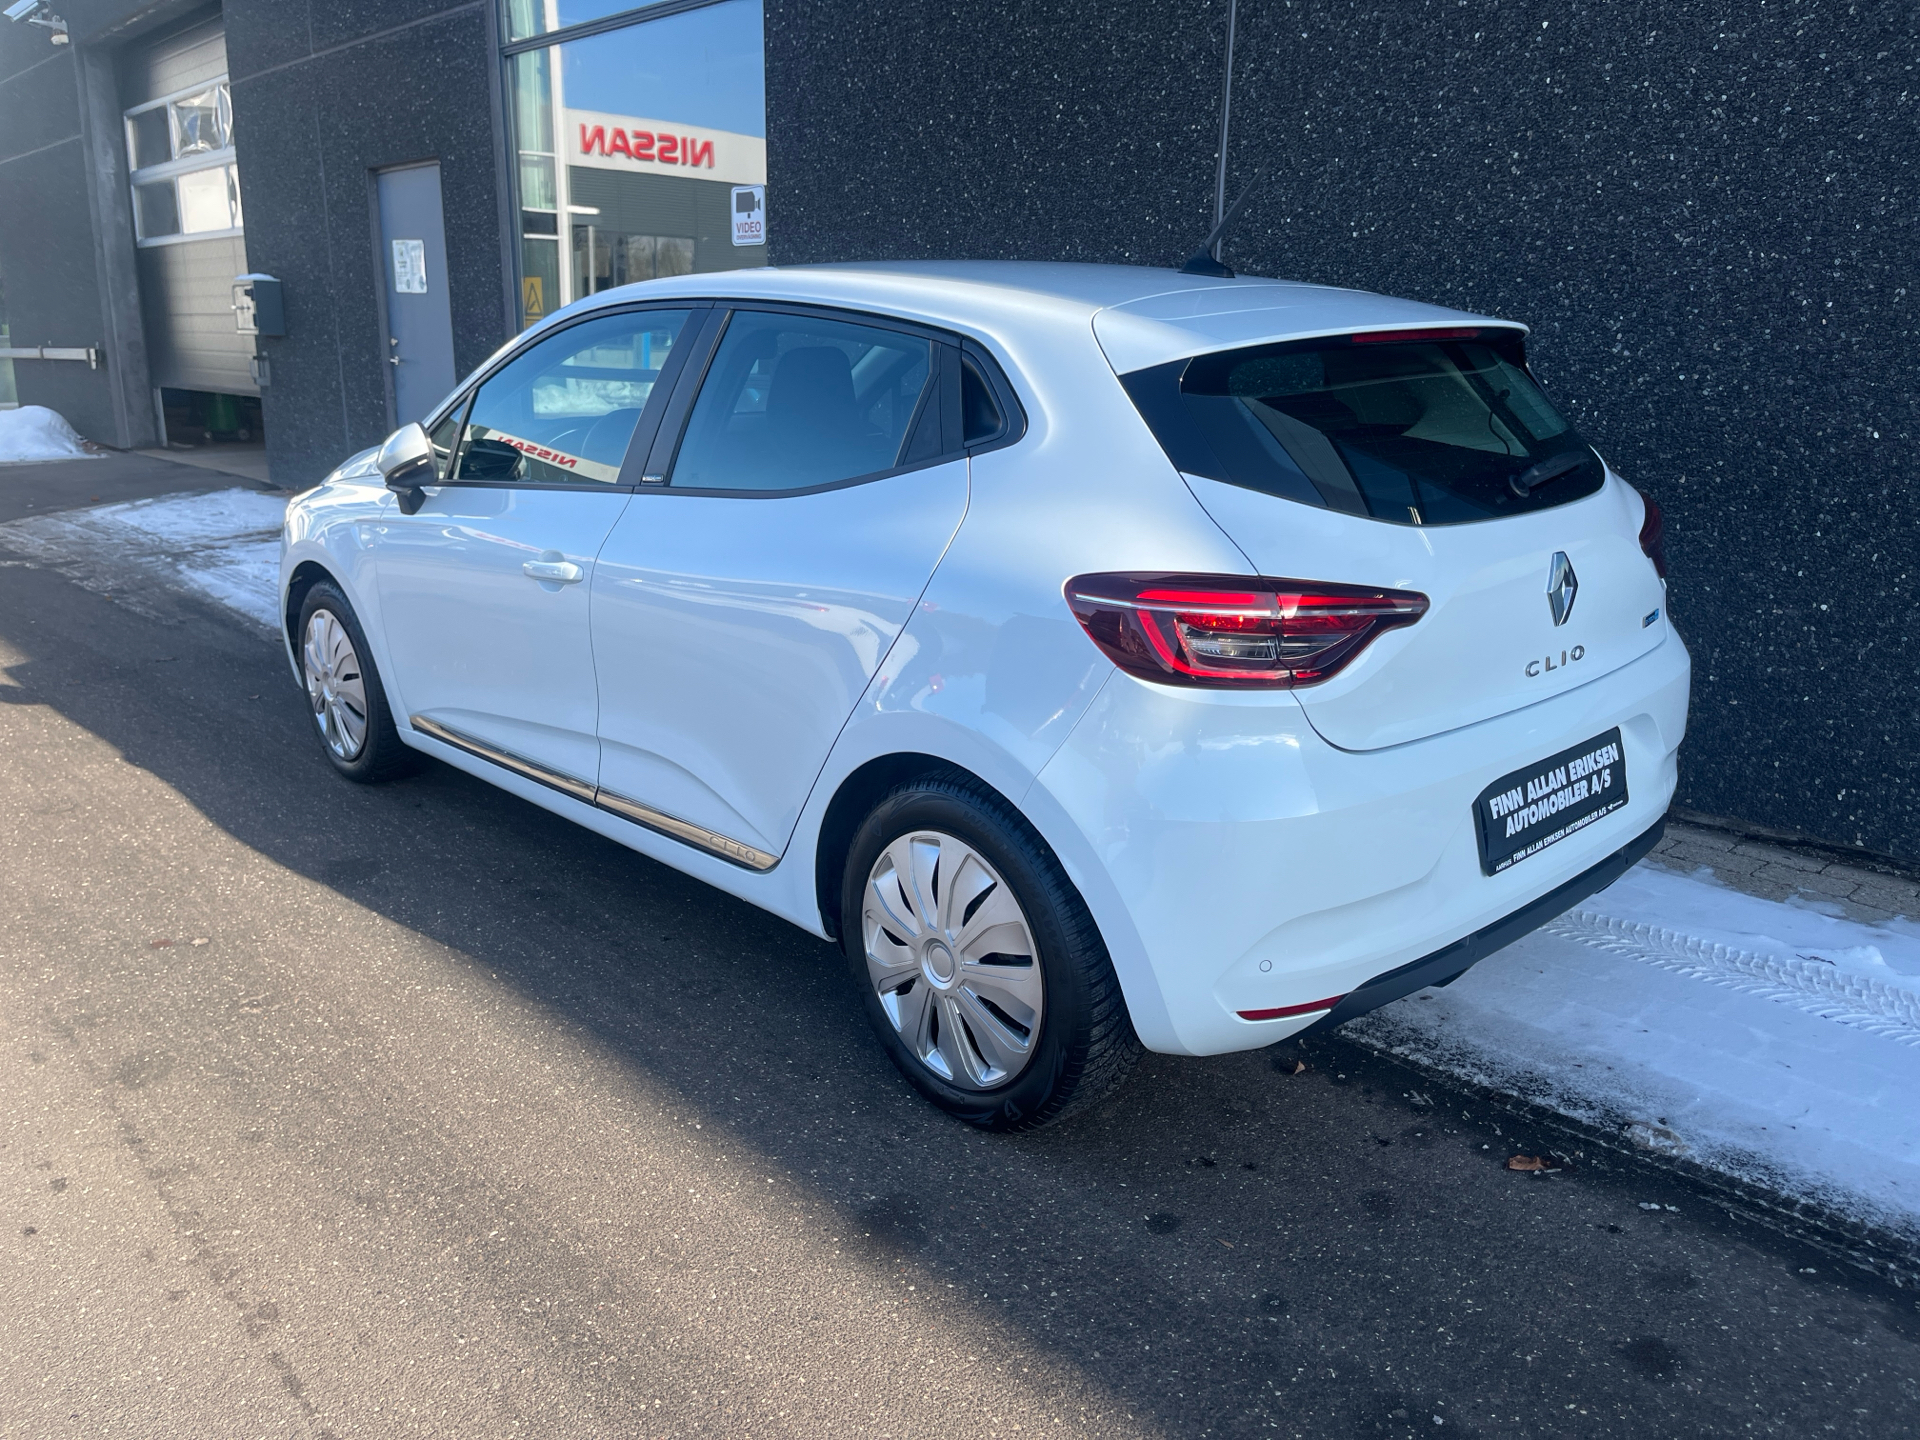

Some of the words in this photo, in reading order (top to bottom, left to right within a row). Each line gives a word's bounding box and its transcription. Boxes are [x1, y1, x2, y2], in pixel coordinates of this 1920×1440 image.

[736, 221, 762, 234] VIDEO
[1525, 645, 1585, 678] CLIO
[1489, 787, 1525, 820] FINN
[1527, 766, 1567, 802] ALLAN
[1569, 743, 1619, 782] ERIKSEN
[1506, 779, 1589, 838] AUTOMOBILER
[1591, 768, 1611, 795] A/S
[710, 836, 756, 864] CLIO
[1513, 850, 1526, 863] FINN
[1526, 839, 1544, 856] ALLAN
[1544, 829, 1565, 847] ERIKSEN
[1565, 810, 1598, 835] AUTOMOBILER
[1598, 806, 1608, 817] A/S
